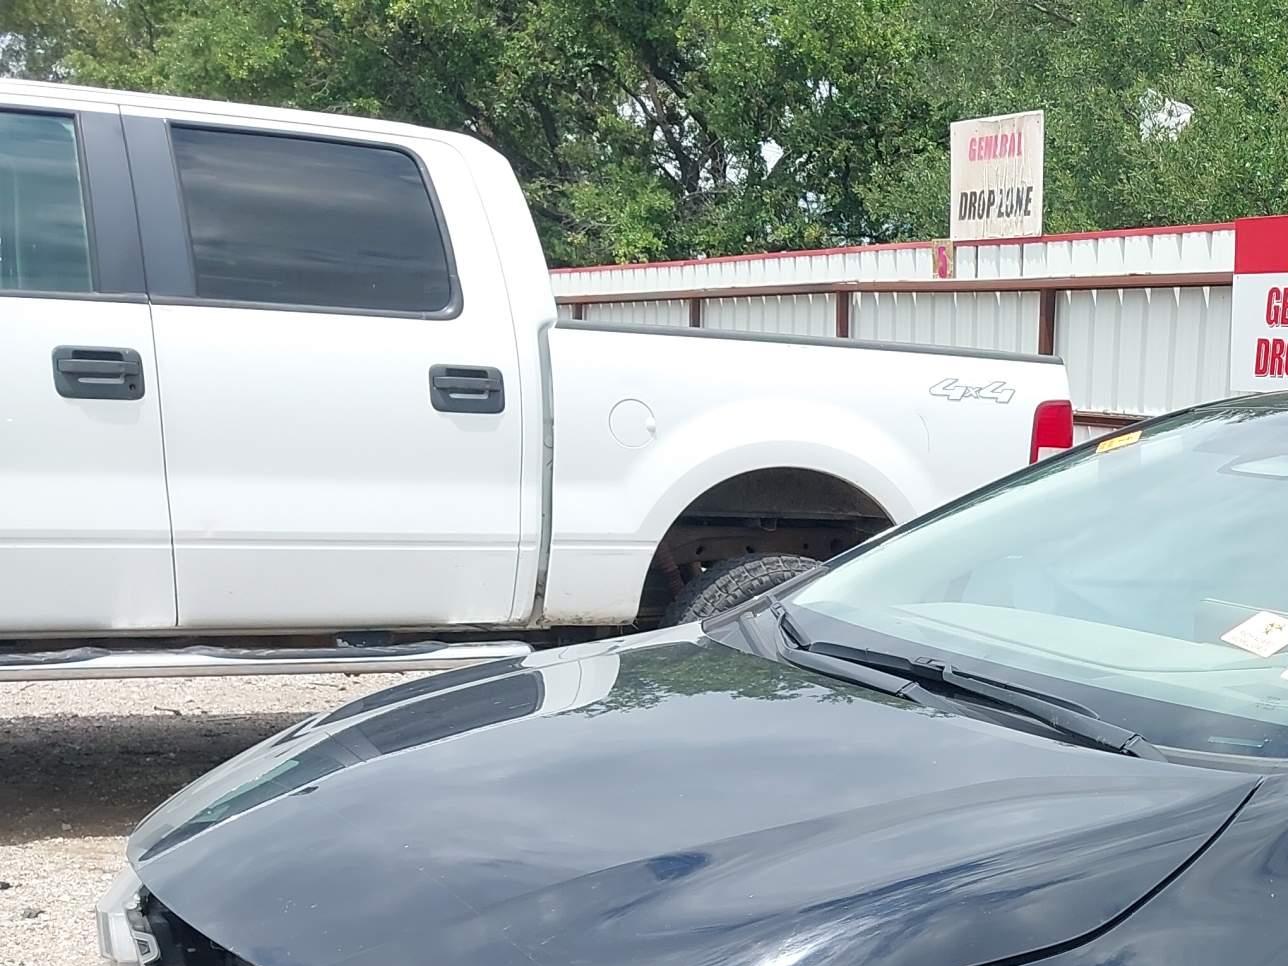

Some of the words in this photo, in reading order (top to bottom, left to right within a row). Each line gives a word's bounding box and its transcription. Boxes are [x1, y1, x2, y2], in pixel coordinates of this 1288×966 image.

[968, 131, 1023, 161] GENERAL
[958, 190, 995, 220] DROP
[997, 186, 1033, 218] ZONE
[929, 378, 1016, 404] 4x4
